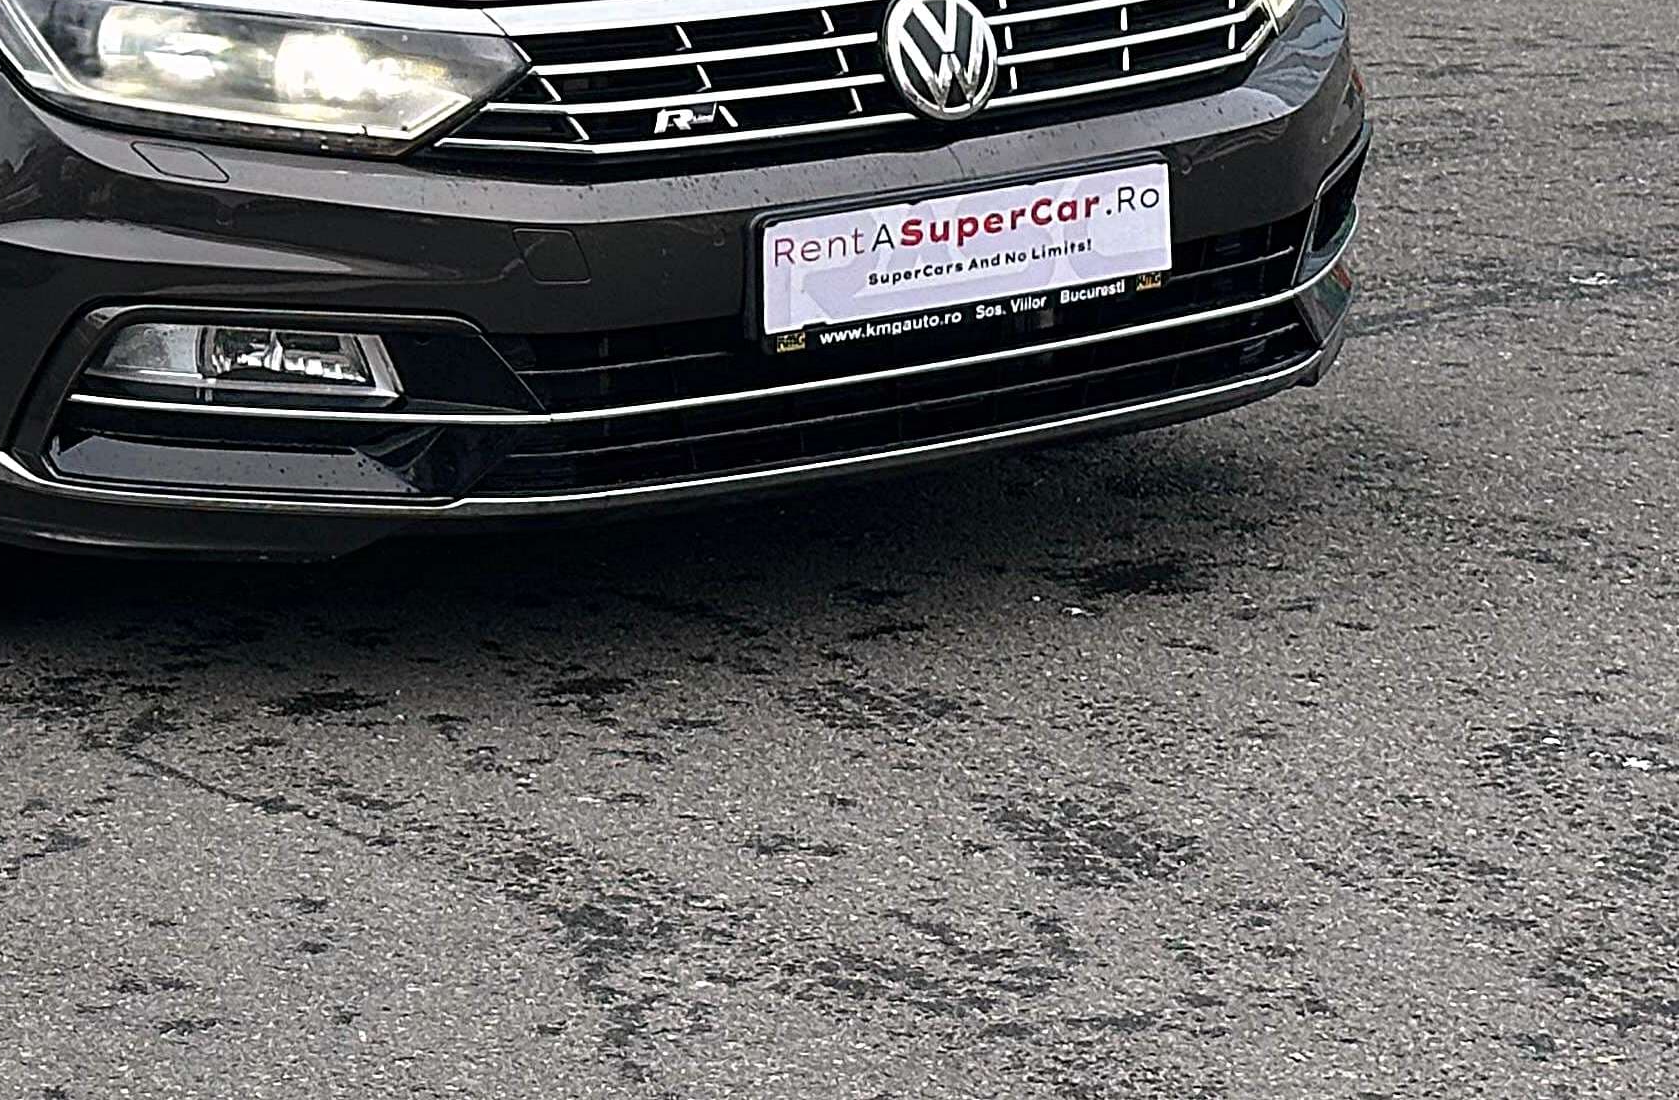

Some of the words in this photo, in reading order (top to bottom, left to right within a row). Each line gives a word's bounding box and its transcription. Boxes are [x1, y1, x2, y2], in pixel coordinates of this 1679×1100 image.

[774, 186, 1160, 267] RentASuperCar.Ro
[868, 263, 963, 286] SuperCars
[968, 256, 1001, 271] And
[1005, 252, 1027, 264] No
[1032, 238, 1092, 260] Limits!
[819, 311, 963, 345] www.kmgauto.ro
[975, 304, 1006, 319] Sos.
